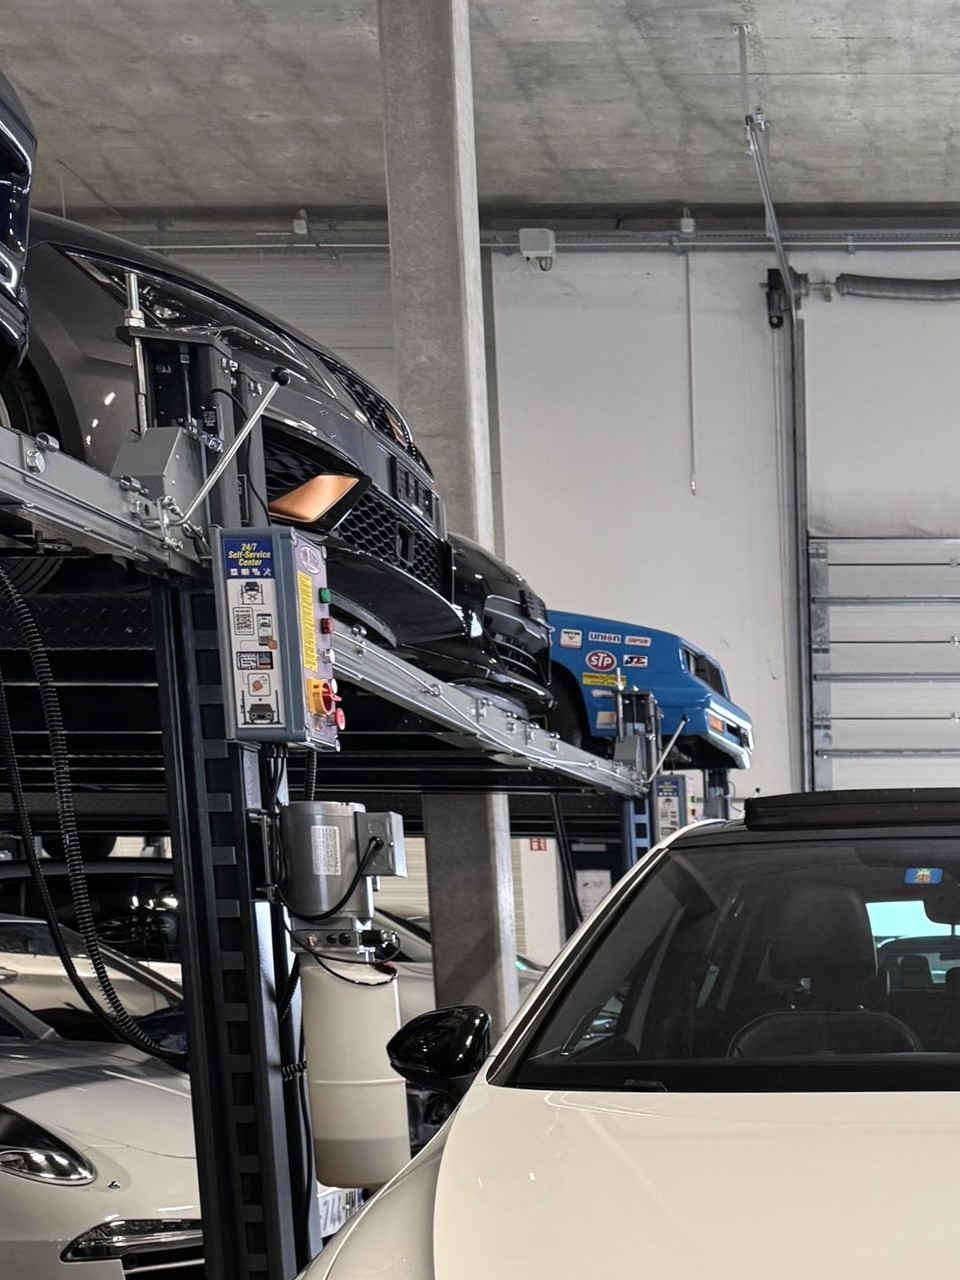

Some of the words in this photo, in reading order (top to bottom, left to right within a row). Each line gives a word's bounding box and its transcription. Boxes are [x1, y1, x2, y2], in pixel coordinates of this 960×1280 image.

[241, 543, 257, 551] 24/7
[228, 550, 271, 559] Self-Service
[238, 558, 262, 567] Center
[591, 653, 612, 667] STP
